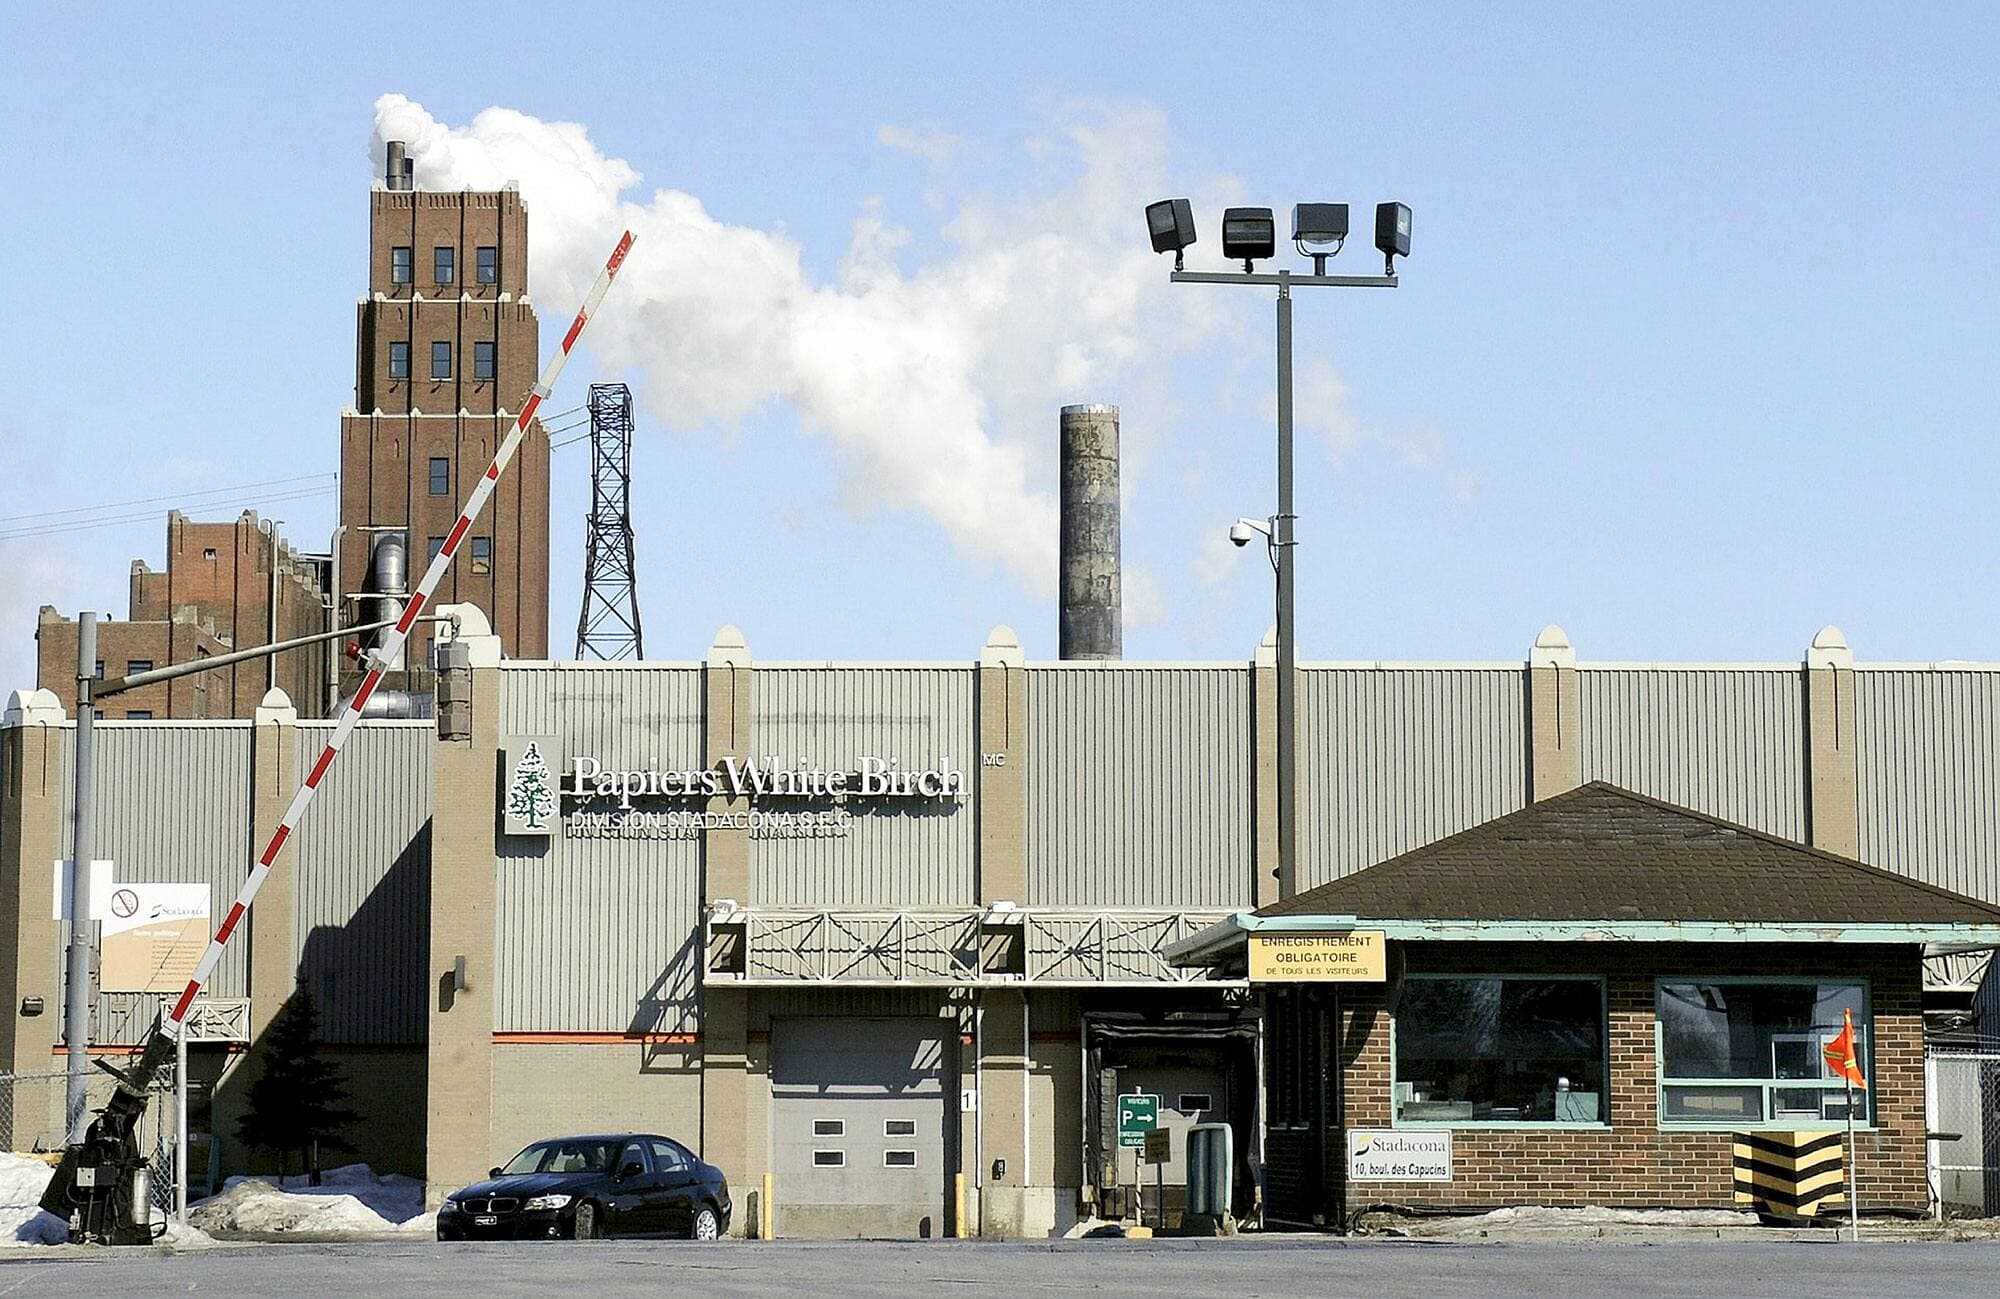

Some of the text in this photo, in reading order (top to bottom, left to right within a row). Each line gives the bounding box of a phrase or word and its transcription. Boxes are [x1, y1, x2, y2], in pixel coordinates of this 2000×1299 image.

[982, 753, 1006, 766] MC
[571, 755, 969, 809] Papiers White Birch
[571, 811, 660, 830] DIVISION
[667, 811, 794, 829] STADACONA
[1261, 936, 1371, 947] ENREGISTREMENT
[1275, 952, 1357, 963] OBLIGATOIRE
[1266, 967, 1369, 975] DE TOUS LES VISITEURS
[962, 1092, 970, 1109] 1
[1122, 1110, 1134, 1126] P
[1372, 1137, 1446, 1152] Stadacona
[1355, 1162, 1446, 1177] 10, boul. des Capucins
